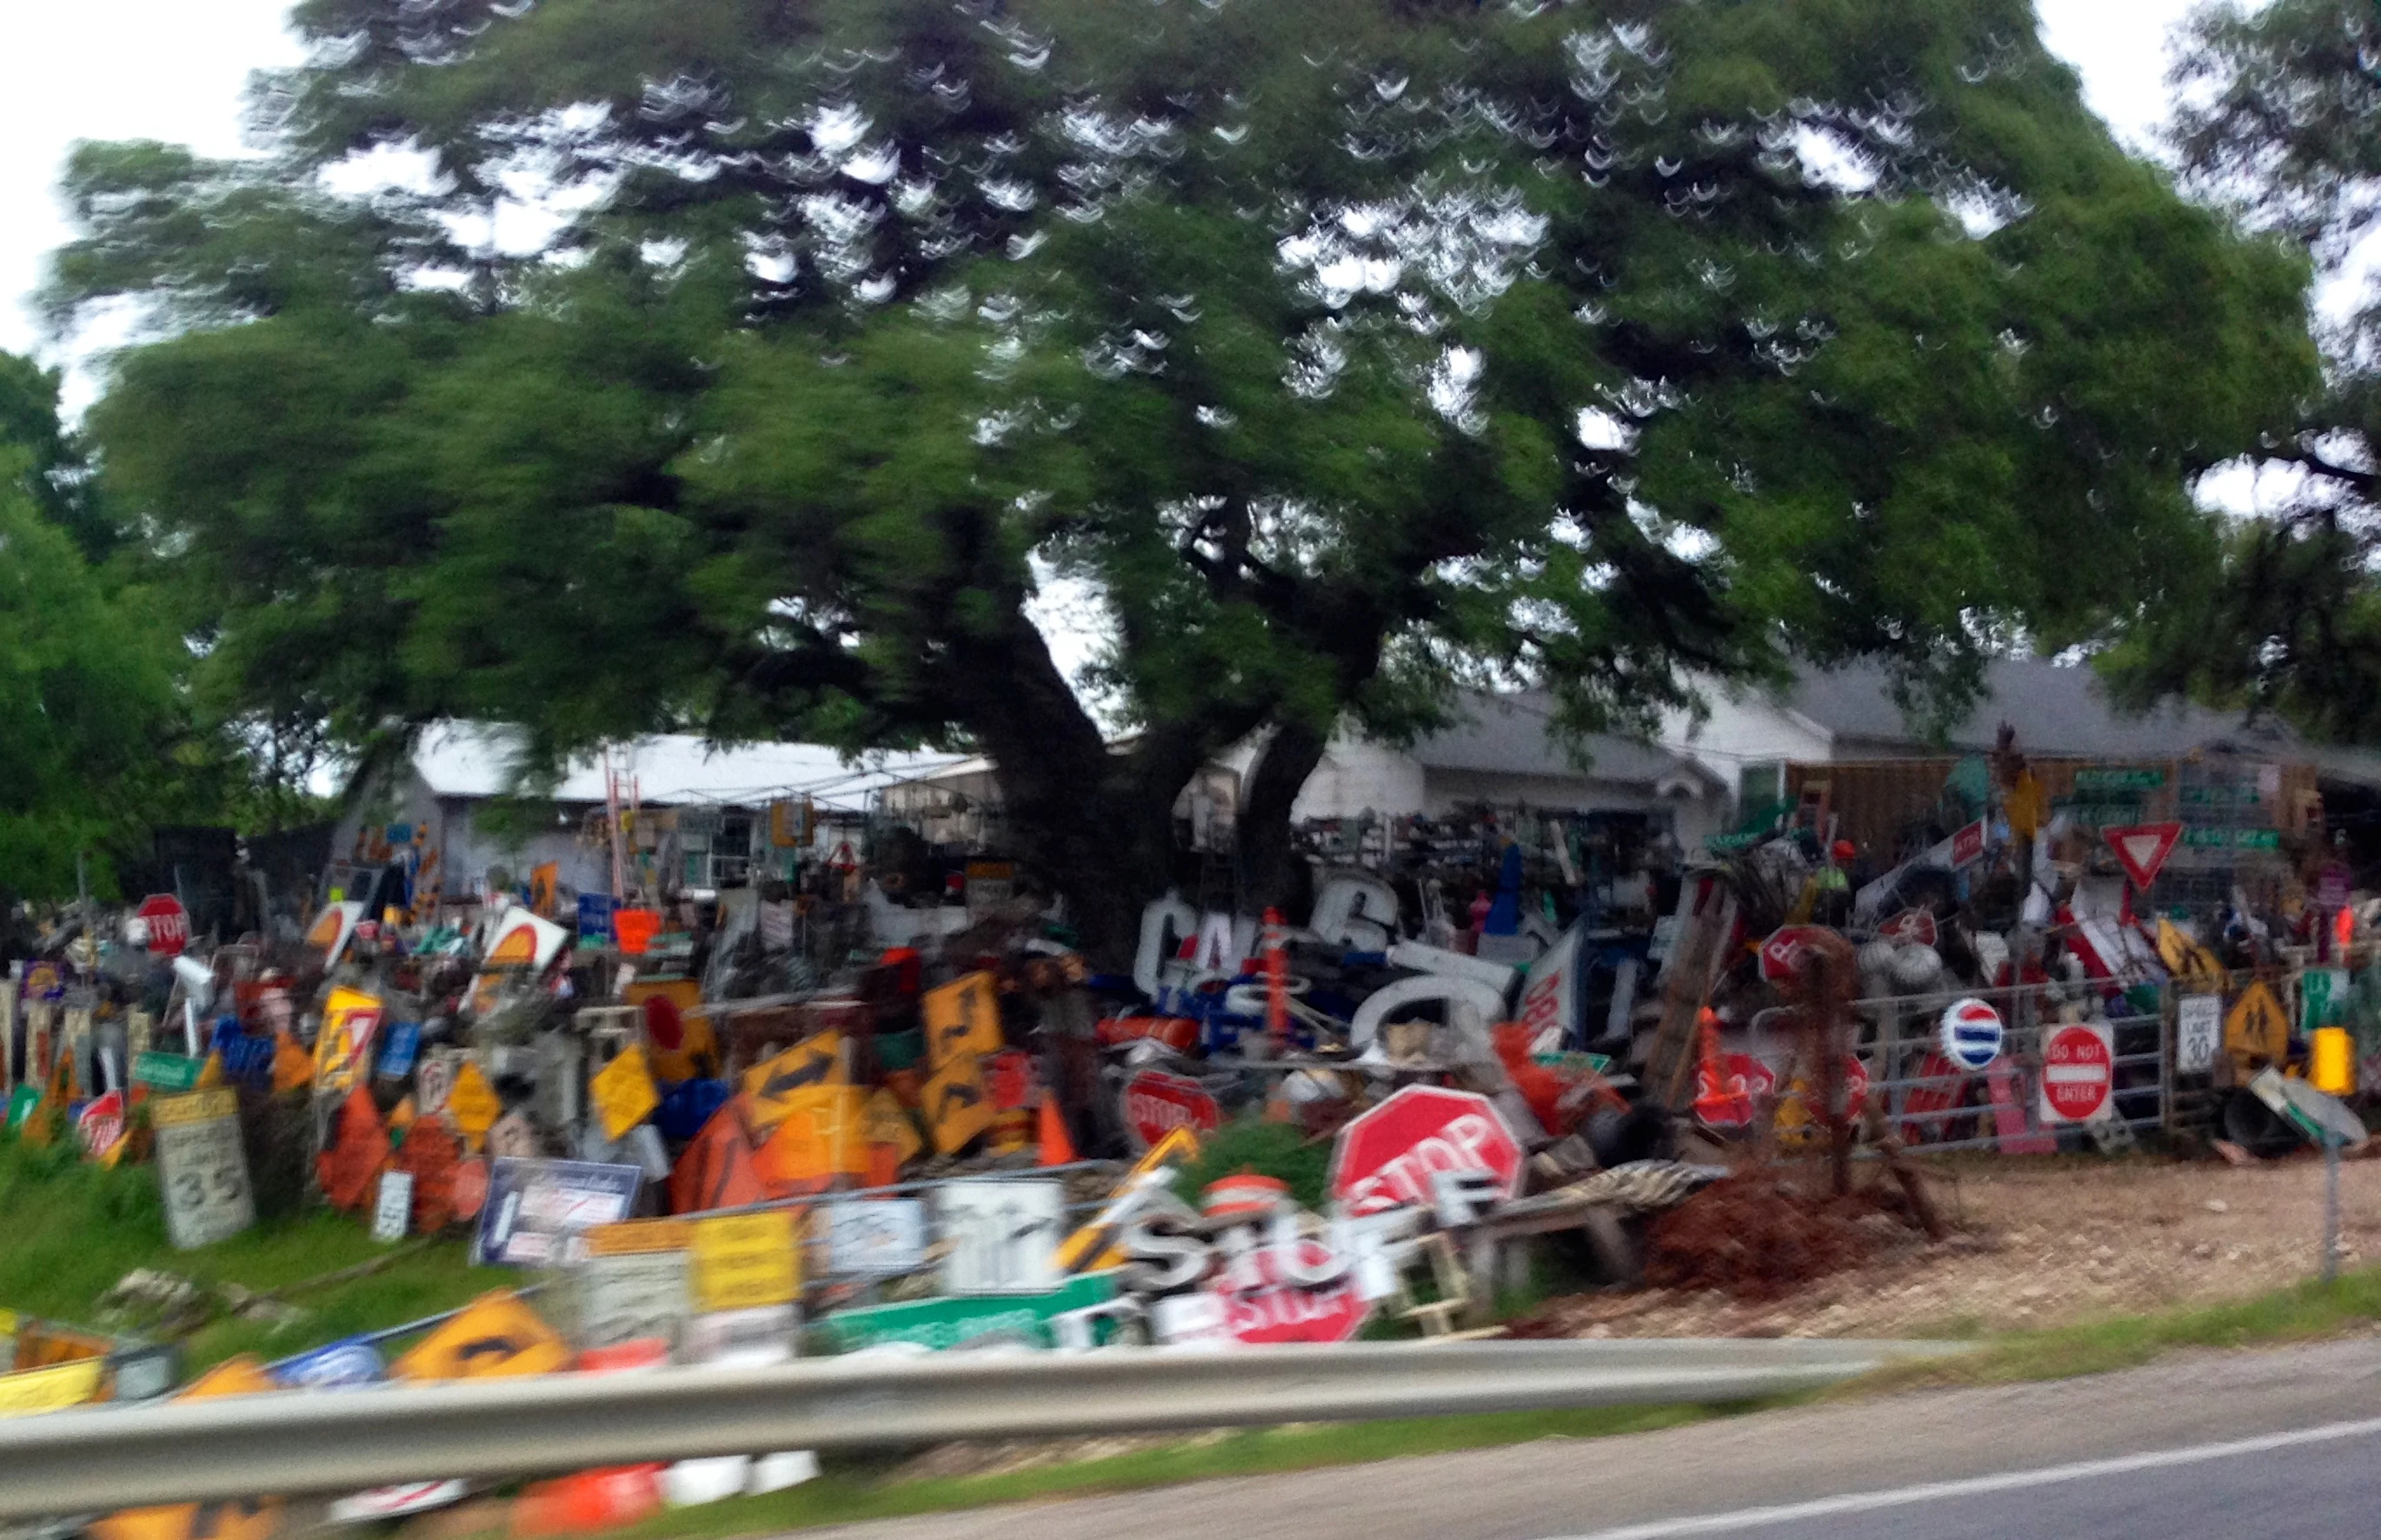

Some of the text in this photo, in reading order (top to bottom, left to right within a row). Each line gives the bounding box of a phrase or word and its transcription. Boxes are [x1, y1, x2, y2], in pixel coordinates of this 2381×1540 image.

[2049, 1043, 2102, 1059] DO NOT
[2187, 1034, 2210, 1065] 30
[1698, 1070, 1770, 1102] SOP
[2056, 1085, 2097, 1103] ENTER
[1346, 1112, 1497, 1217] STOP
[174, 1165, 242, 1211] 35
